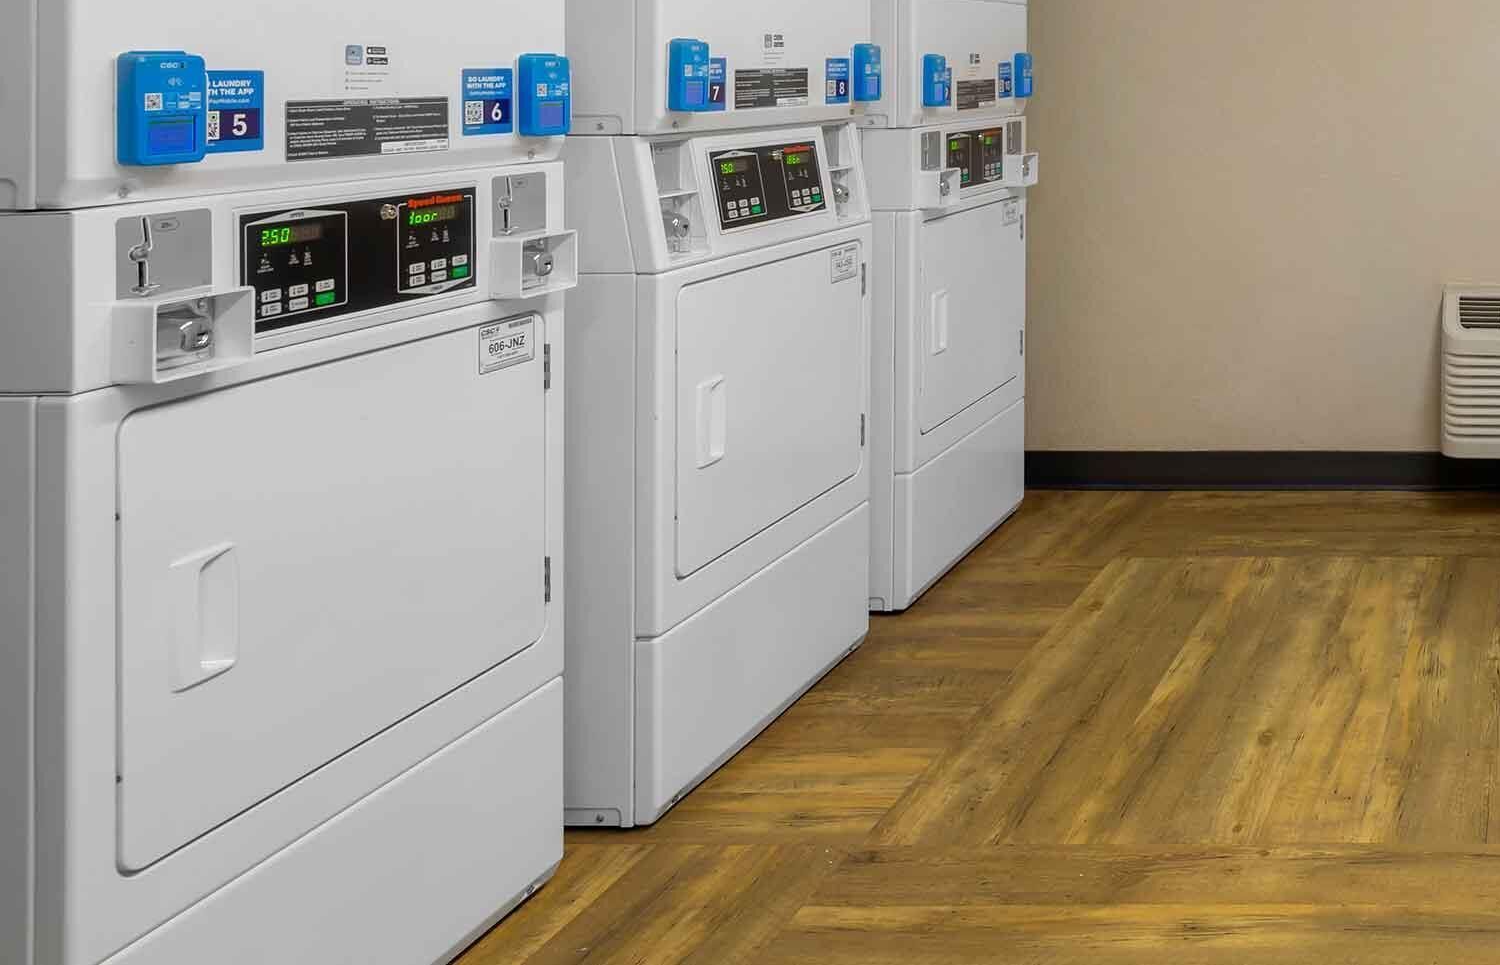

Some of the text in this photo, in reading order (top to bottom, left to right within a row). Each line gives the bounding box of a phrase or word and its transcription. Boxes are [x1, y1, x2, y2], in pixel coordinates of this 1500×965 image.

[713, 86, 720, 100] 7
[840, 82, 845, 94] 8
[491, 103, 502, 121] 6
[232, 114, 247, 136] 5
[489, 335, 526, 354] 606-JNZ
